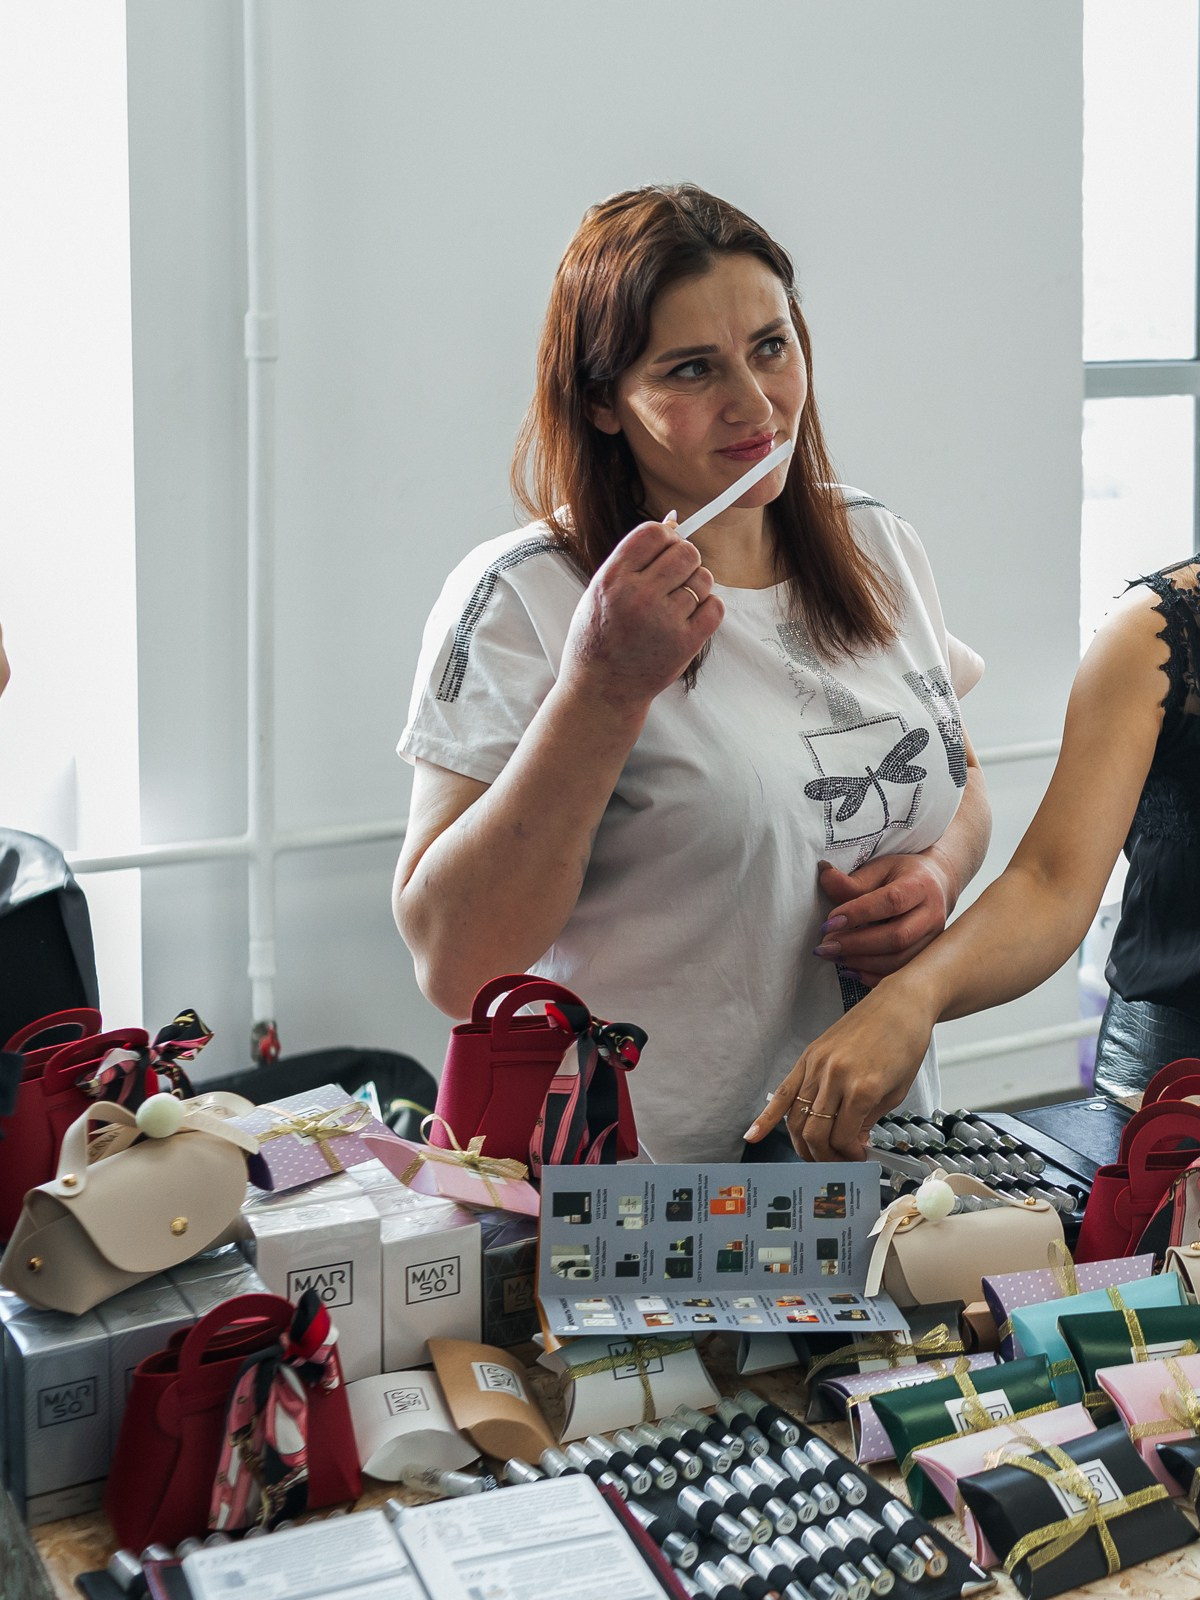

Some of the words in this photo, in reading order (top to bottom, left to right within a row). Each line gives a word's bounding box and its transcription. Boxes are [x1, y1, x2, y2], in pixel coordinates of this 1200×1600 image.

[411, 1264, 454, 1284] MAR
[420, 1278, 447, 1296] SO
[45, 1385, 91, 1408] MAR
[52, 1401, 82, 1419] SO
